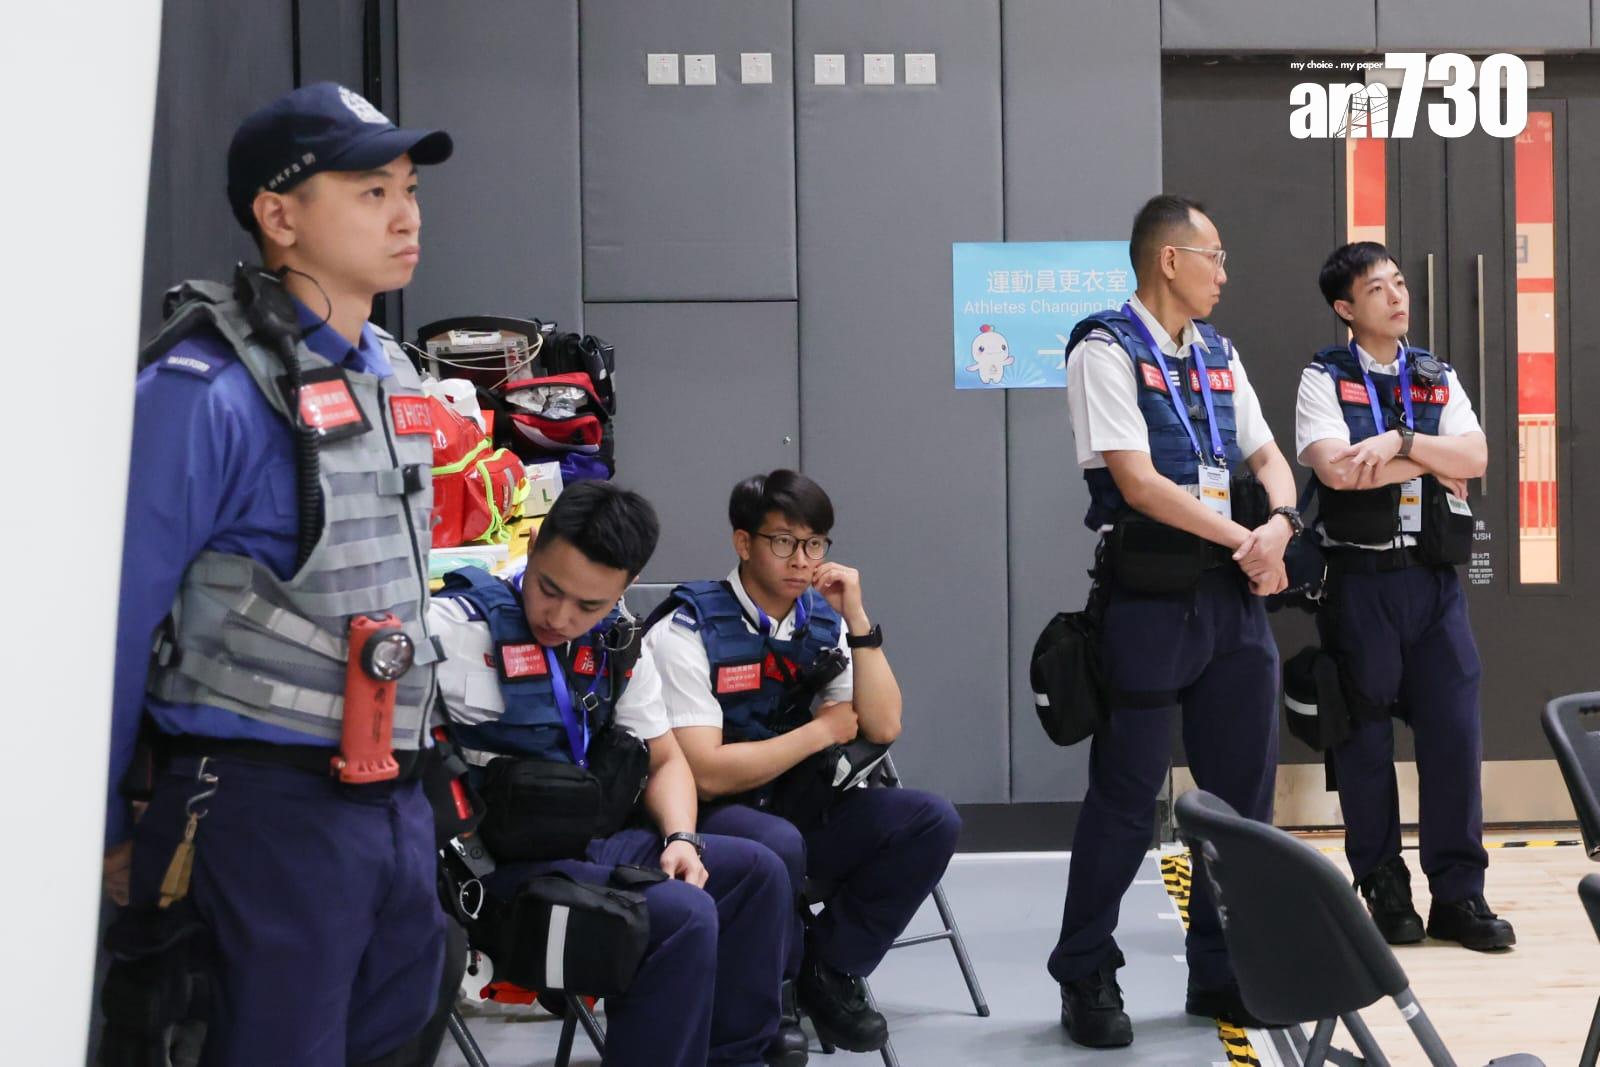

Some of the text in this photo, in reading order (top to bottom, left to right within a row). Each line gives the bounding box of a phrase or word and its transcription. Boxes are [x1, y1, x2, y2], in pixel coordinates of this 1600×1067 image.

[986, 268, 1129, 294] 運動員更衣室
[964, 301, 1026, 314] Athletes
